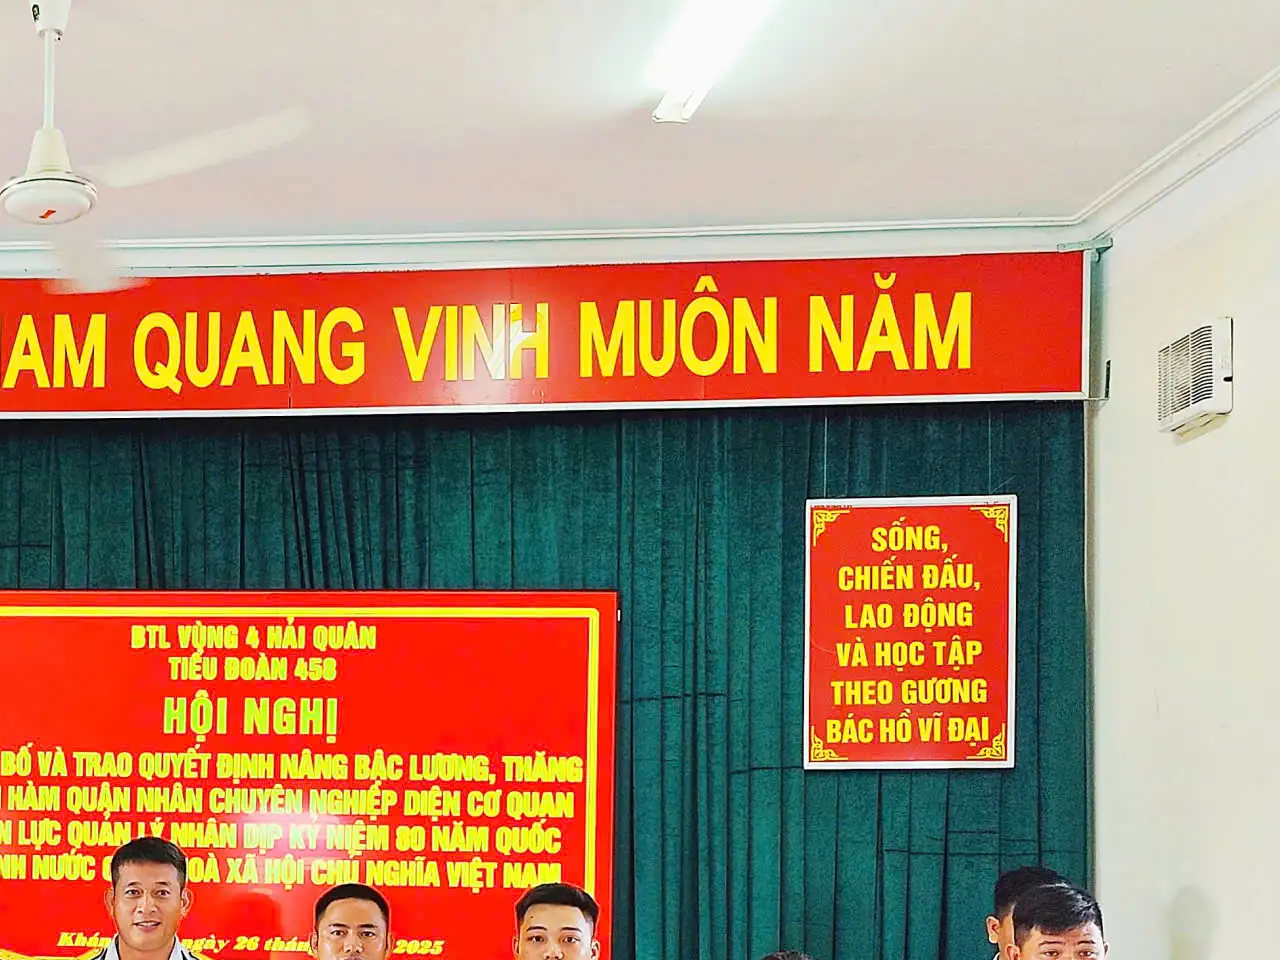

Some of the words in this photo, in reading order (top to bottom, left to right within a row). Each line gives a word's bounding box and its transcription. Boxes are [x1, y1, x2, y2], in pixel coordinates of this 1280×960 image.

[133, 307, 366, 392] QUANG
[393, 301, 549, 381] VINH
[578, 275, 778, 379] MUÔN
[807, 272, 973, 373] NĂM
[872, 516, 948, 553] SỐNG,
[838, 556, 913, 591] CHIẾN
[922, 554, 980, 591] ĐẤU,
[131, 625, 170, 648] BTL
[178, 620, 238, 649] VÙNG
[245, 625, 259, 648] 4
[267, 616, 305, 649] HẢI
[312, 620, 377, 650] QUÂN
[844, 603, 893, 629] LAO
[903, 597, 973, 632] ĐỘNG
[168, 648, 217, 681] TIỂU
[224, 652, 287, 681] ĐOÀN
[294, 657, 337, 681] 458
[836, 636, 868, 667] VÀ
[876, 641, 925, 672] HỌC
[933, 634, 983, 671] TẬP
[831, 680, 893, 705] THEO
[901, 677, 987, 704] GƯƠNG
[164, 689, 227, 742] HỘI
[244, 697, 338, 744] NGHỊ
[826, 712, 874, 743] BÁC
[880, 709, 912, 742] HỒ
[918, 712, 941, 742] VĨ
[948, 716, 989, 746] ĐẠI
[0, 742, 33, 776] BỐ
[37, 746, 68, 777] VÀ
[74, 752, 133, 778] TRAO
[138, 744, 212, 780] QUYẾT
[216, 753, 274, 785] ĐỊNH
[280, 748, 347, 780] NÂNG
[409, 752, 495, 785] LƯƠNG,
[504, 750, 583, 783] THĂNG
[8, 781, 60, 812] HÀM
[136, 782, 202, 813] NHÂN
[209, 785, 302, 814] CHUYÊN
[309, 785, 397, 821] NGHIỆP
[404, 785, 460, 821] DIỆN
[467, 789, 502, 818] CƠ
[507, 791, 574, 820] QUAN
[19, 819, 61, 850] LỰC
[68, 810, 131, 848] QUẢN
[171, 818, 237, 848] NHÂN
[244, 823, 282, 856] DỊP
[327, 820, 389, 857] NIỆM
[396, 825, 426, 851] 80
[432, 822, 489, 853] NĂM
[496, 818, 561, 854] QUỐC
[32, 848, 95, 880] NƯỚC
[226, 851, 256, 884] XÃ
[265, 854, 304, 890] HỘI
[366, 856, 440, 887] NGHĨA
[447, 856, 497, 893] VIỆT
[504, 863, 562, 889] NAM
[57, 932, 112, 948] Khán
[180, 934, 230, 953] ngày
[234, 936, 258, 951] 26
[393, 940, 444, 955] 2025
